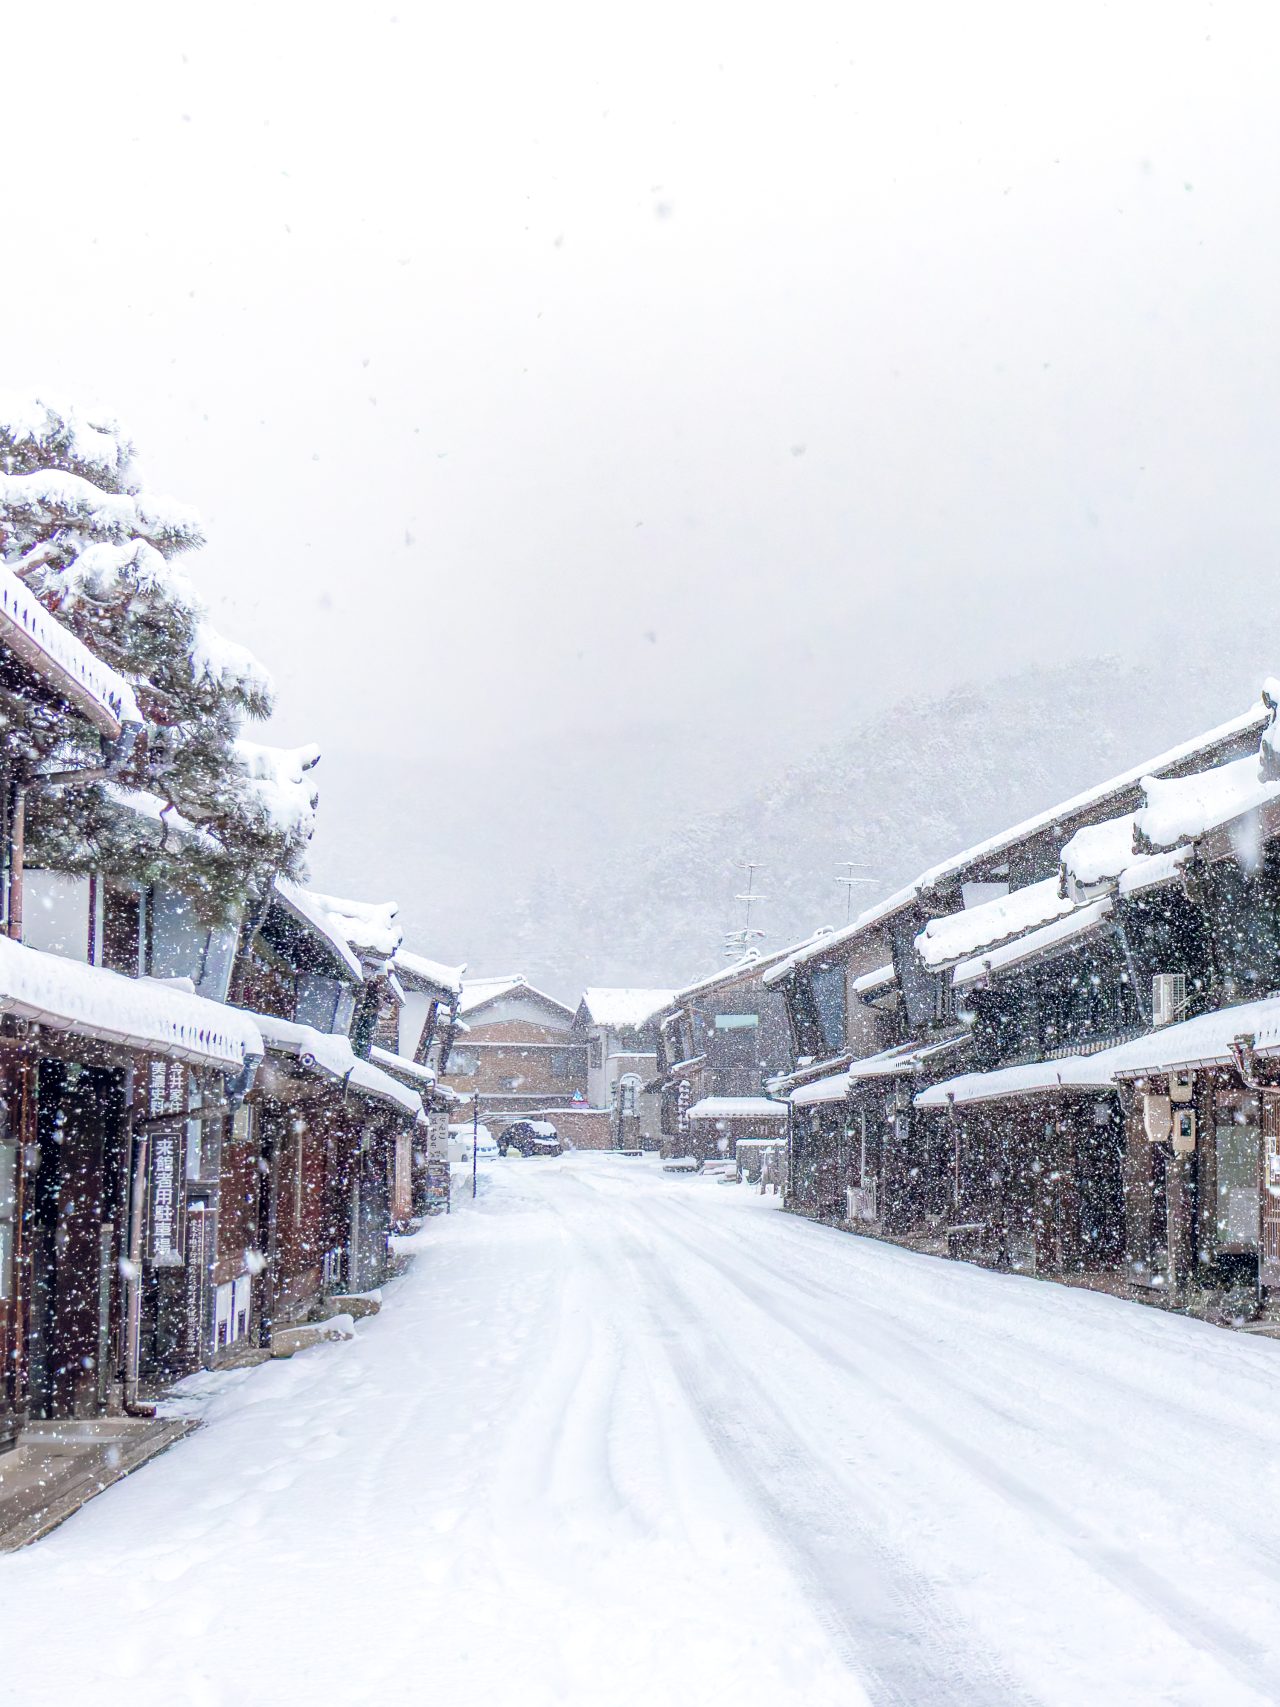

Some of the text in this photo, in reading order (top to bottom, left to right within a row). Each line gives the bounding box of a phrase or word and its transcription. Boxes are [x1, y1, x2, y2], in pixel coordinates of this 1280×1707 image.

[151, 1061, 167, 1118] 美濃史料
[170, 1062, 184, 1128] 今井家住
[154, 1139, 174, 1255] 来館者用駐車場
